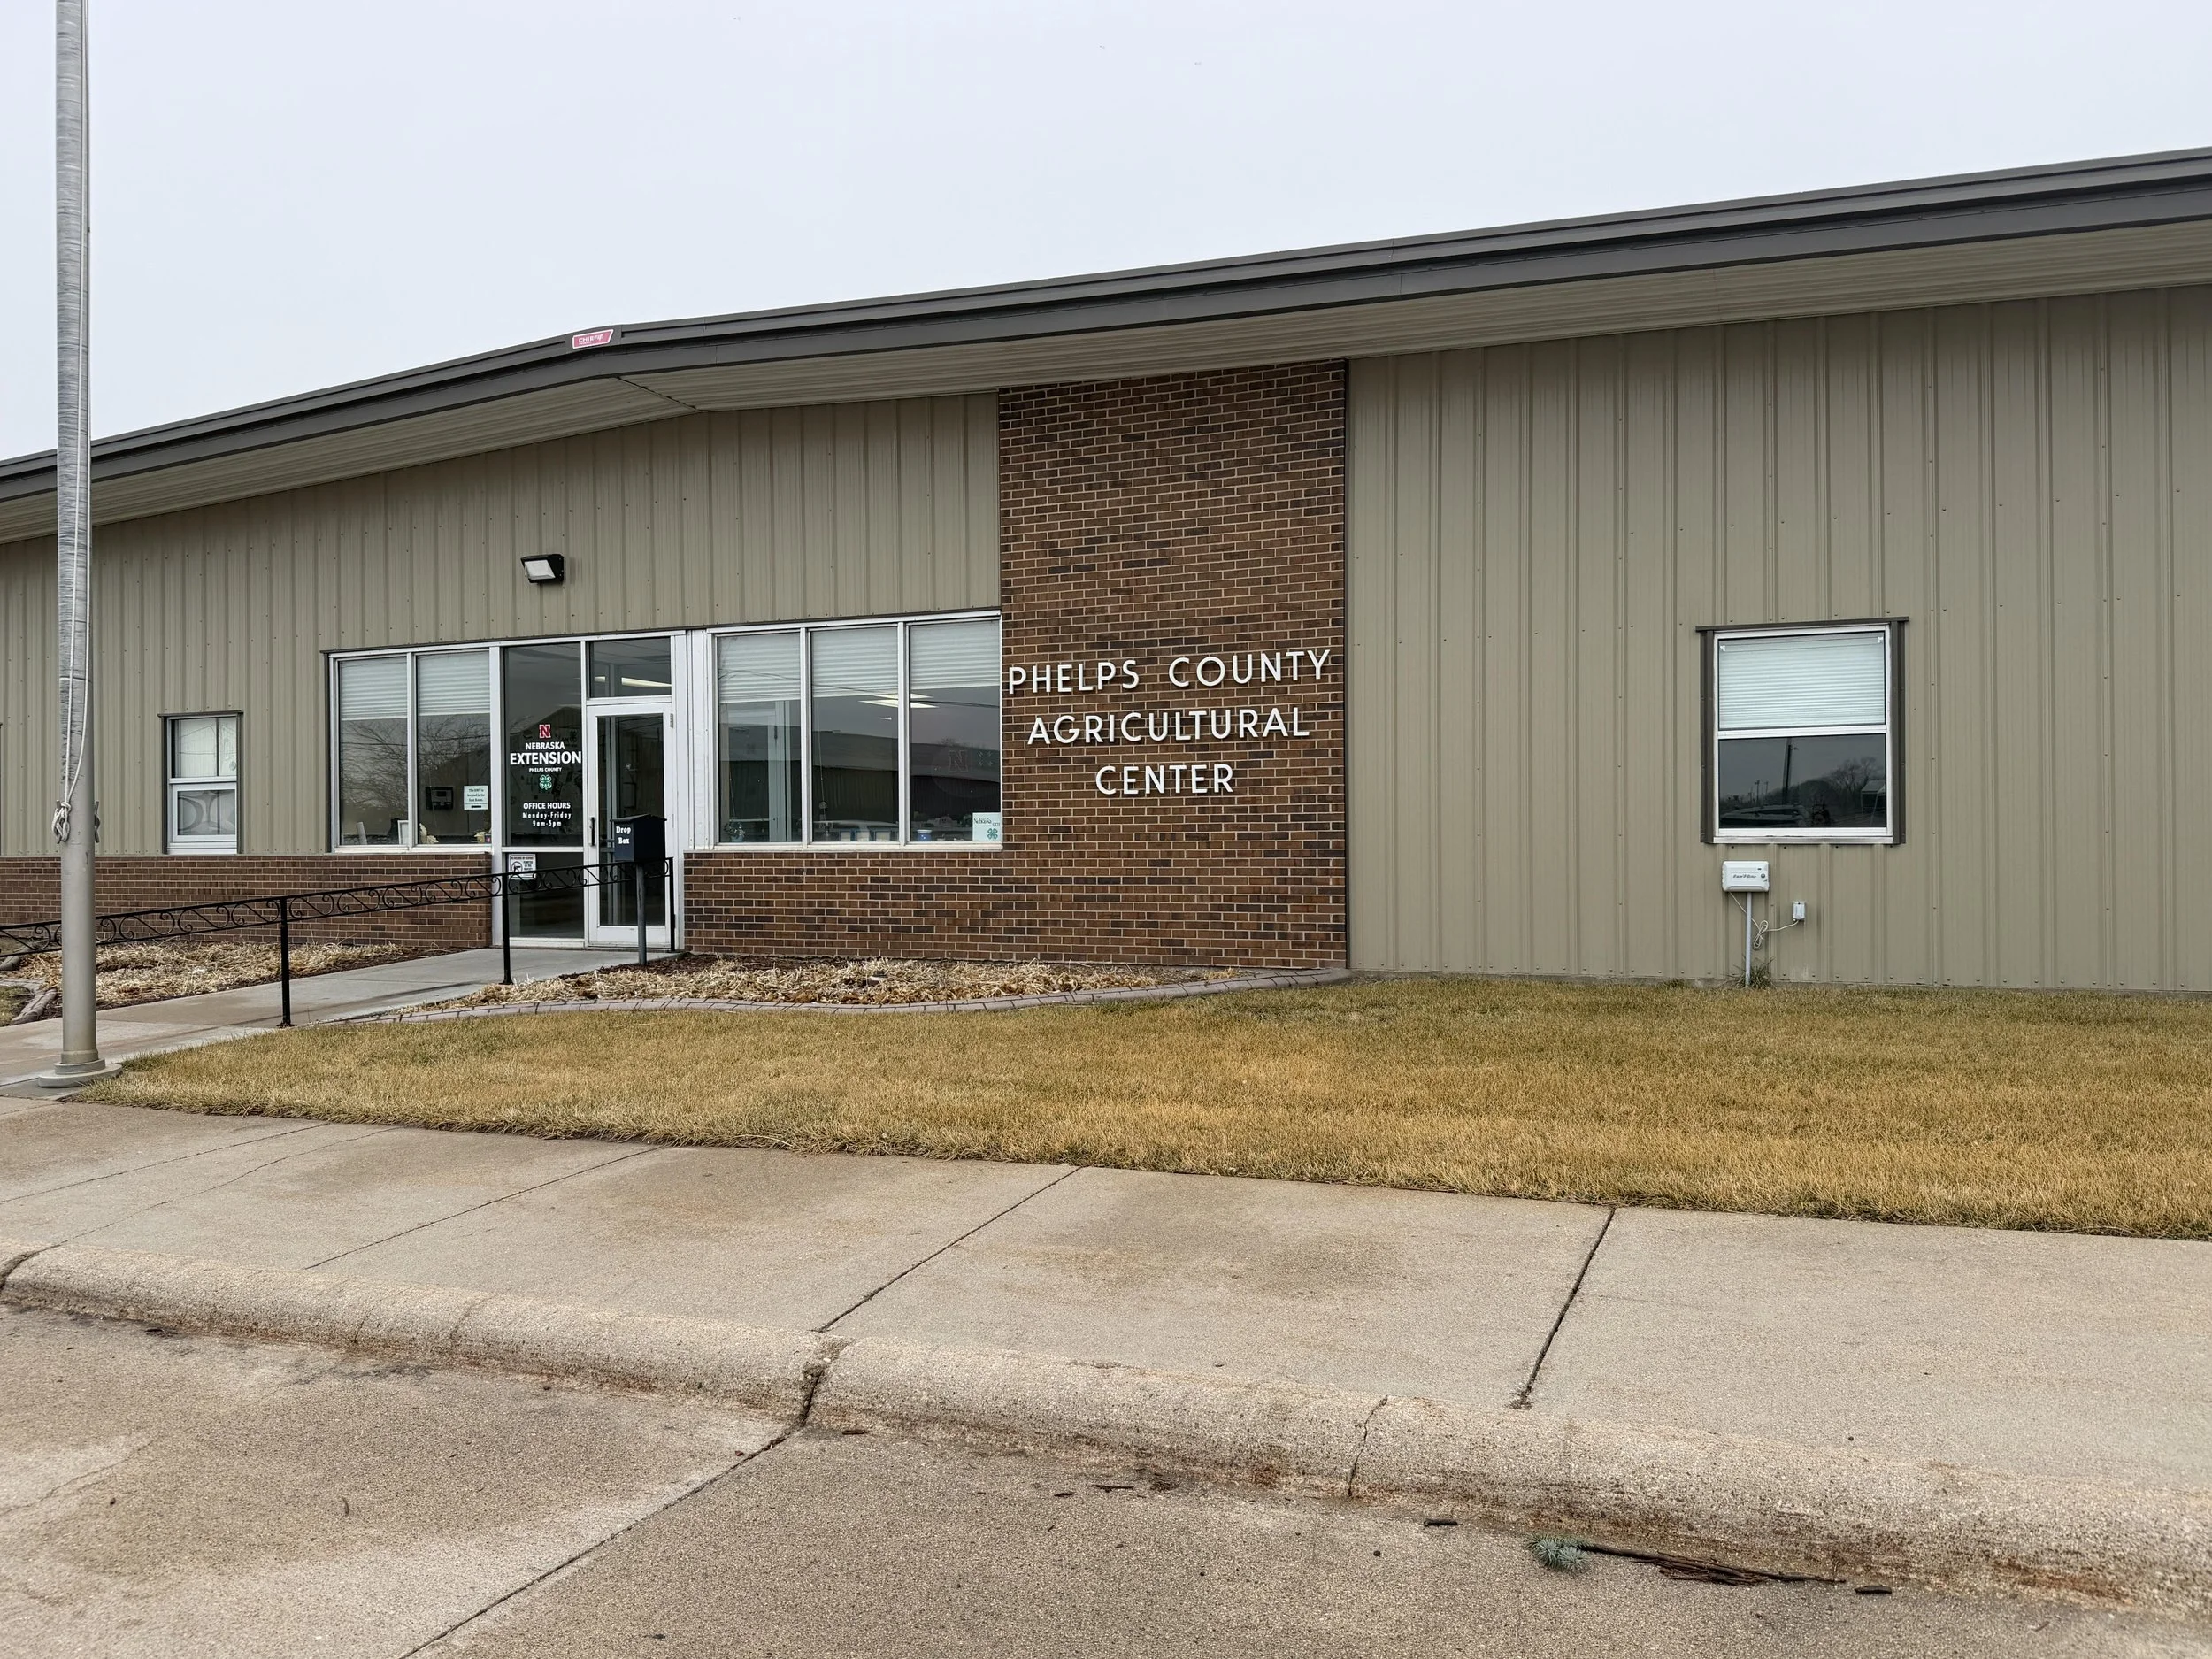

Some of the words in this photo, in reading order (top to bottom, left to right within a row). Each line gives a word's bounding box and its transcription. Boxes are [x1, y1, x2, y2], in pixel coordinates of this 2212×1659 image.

[1009, 659, 1140, 694] PHELPS
[1169, 649, 1330, 687] COUNTY
[539, 724, 551, 738] N
[1027, 707, 1310, 746] AGRICULTURAL
[525, 741, 565, 750] NEBRASKA
[510, 751, 581, 765] EXTENSION
[1095, 764, 1233, 795] CENTER
[522, 811, 572, 820] Monday-Friday
[532, 819, 562, 828] 9am-5pm
[616, 826, 632, 835] Drop
[618, 836, 630, 845] Box
